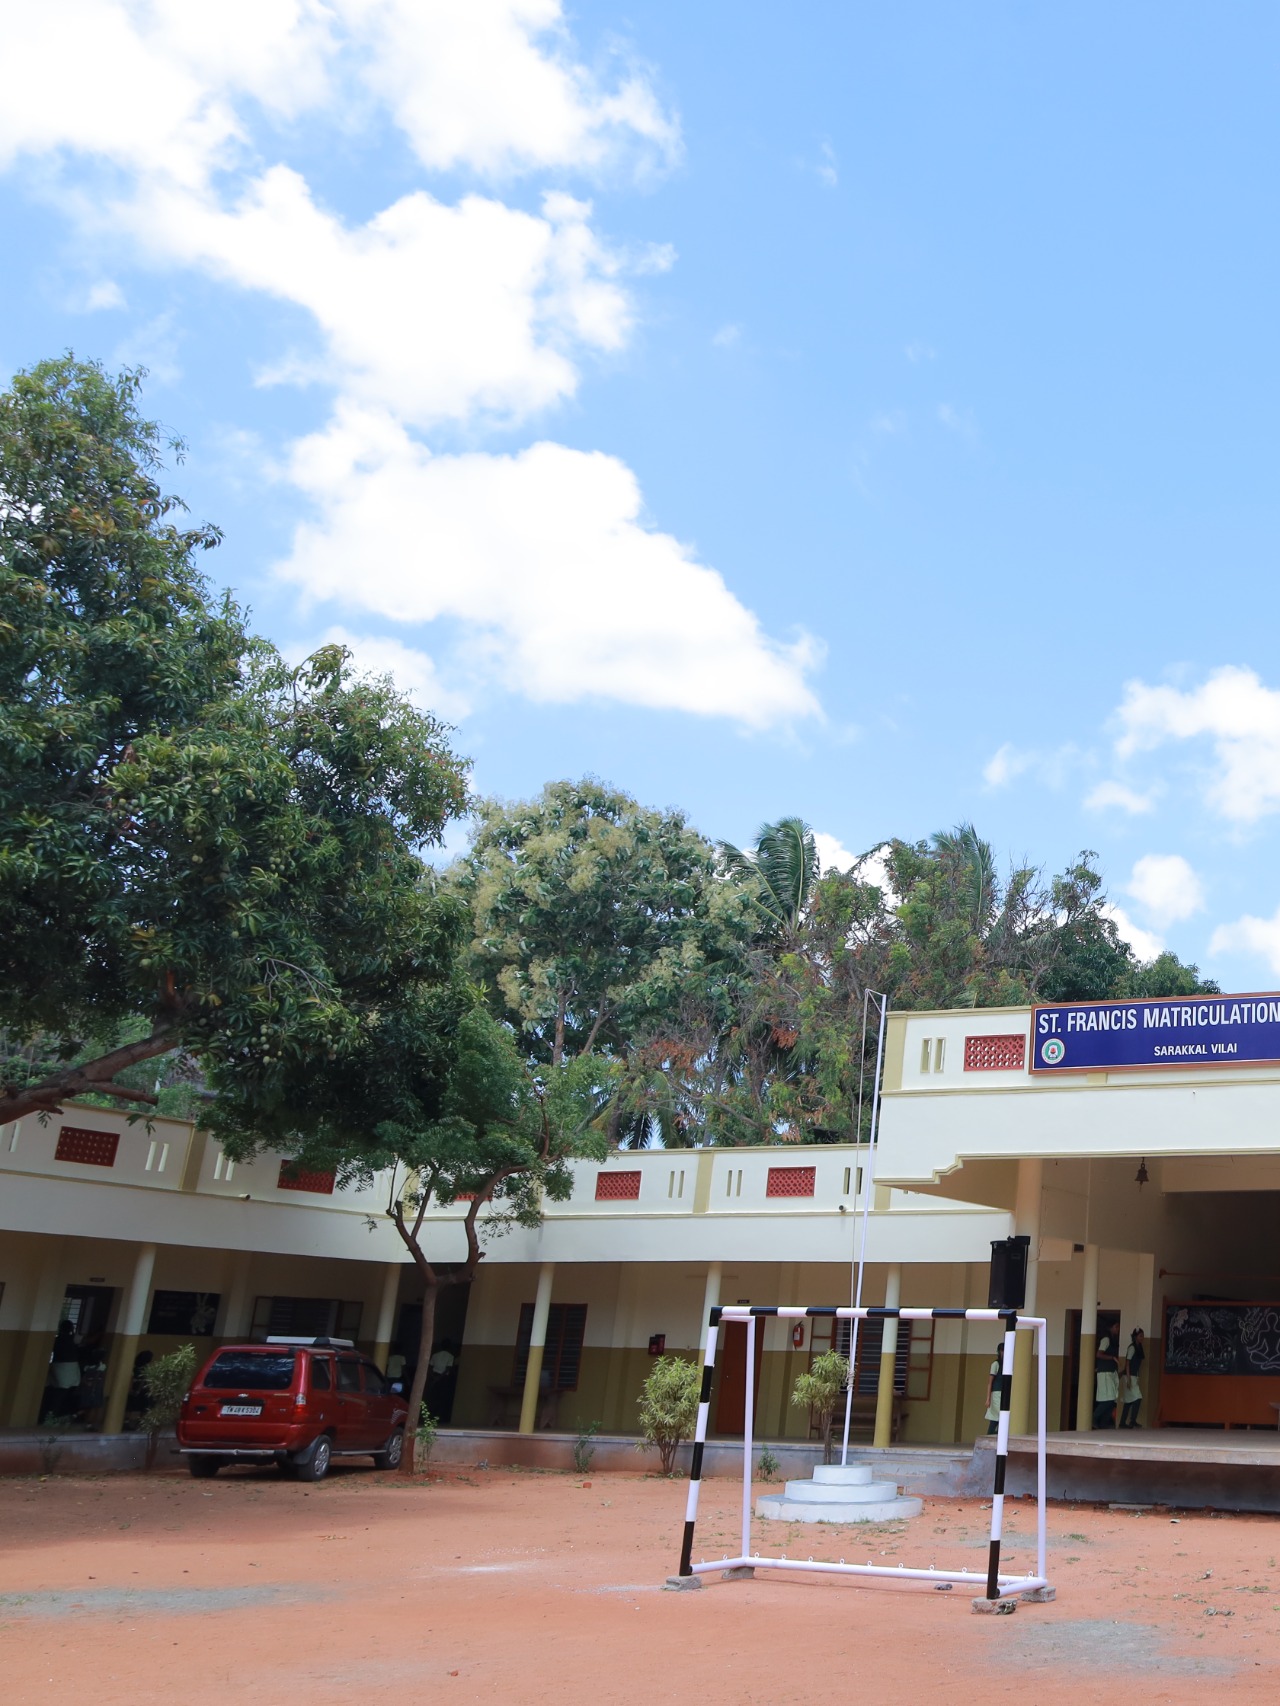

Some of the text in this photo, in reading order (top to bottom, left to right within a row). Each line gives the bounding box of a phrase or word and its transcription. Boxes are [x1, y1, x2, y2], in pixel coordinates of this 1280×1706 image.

[1038, 1013, 1062, 1034] ST.
[1067, 1008, 1137, 1032] FRANCIS
[1143, 1002, 1280, 1028] MATRICULATION
[1153, 1043, 1238, 1056] SARAKKAL VILAI
